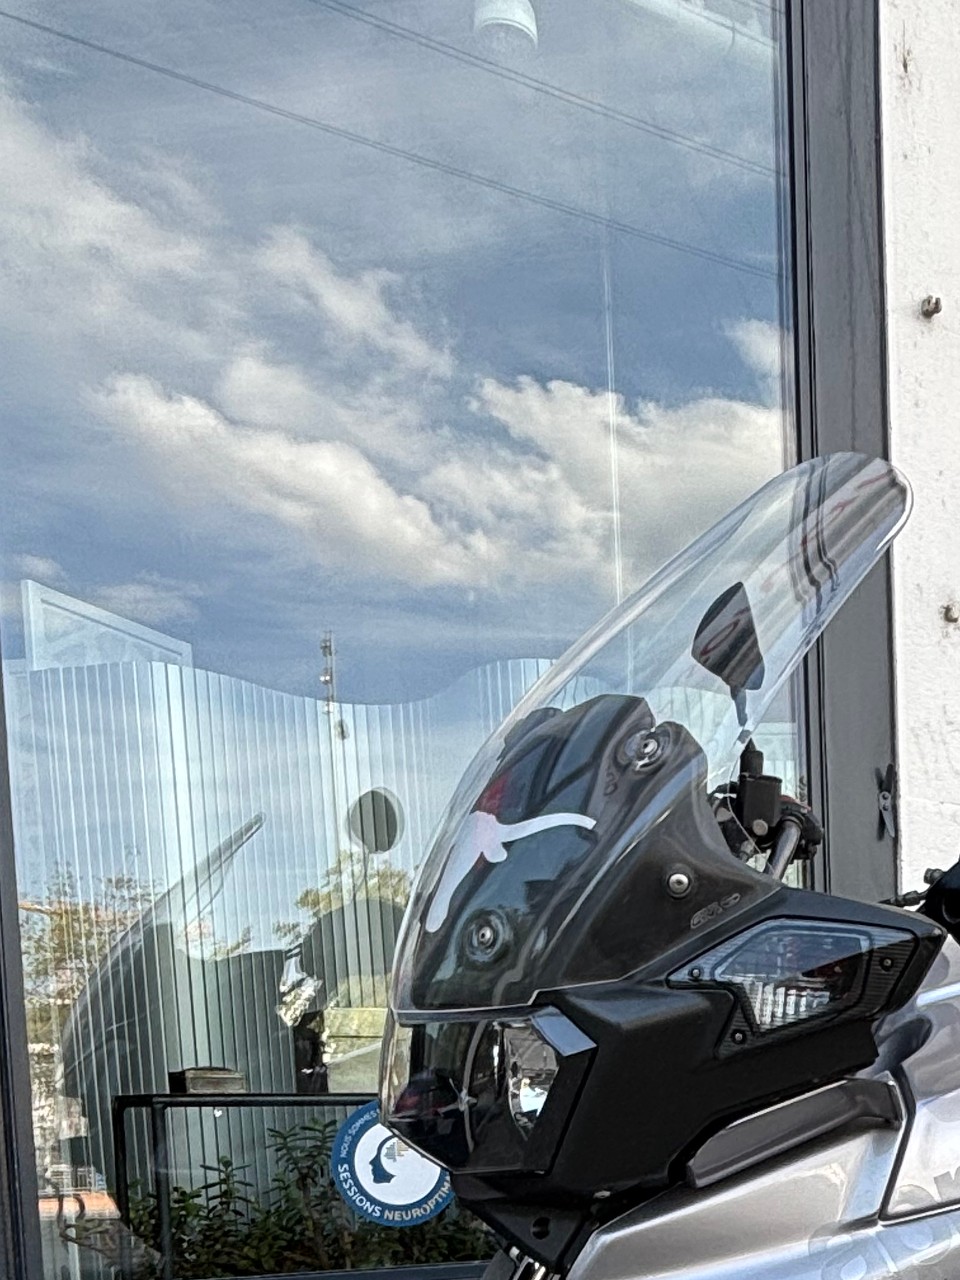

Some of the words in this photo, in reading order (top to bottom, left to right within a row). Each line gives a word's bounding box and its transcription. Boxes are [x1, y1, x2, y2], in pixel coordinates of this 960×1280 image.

[340, 1134, 352, 1158] NOUS
[348, 1110, 377, 1136] SOMMES
[338, 1163, 382, 1217] SESSIONS
